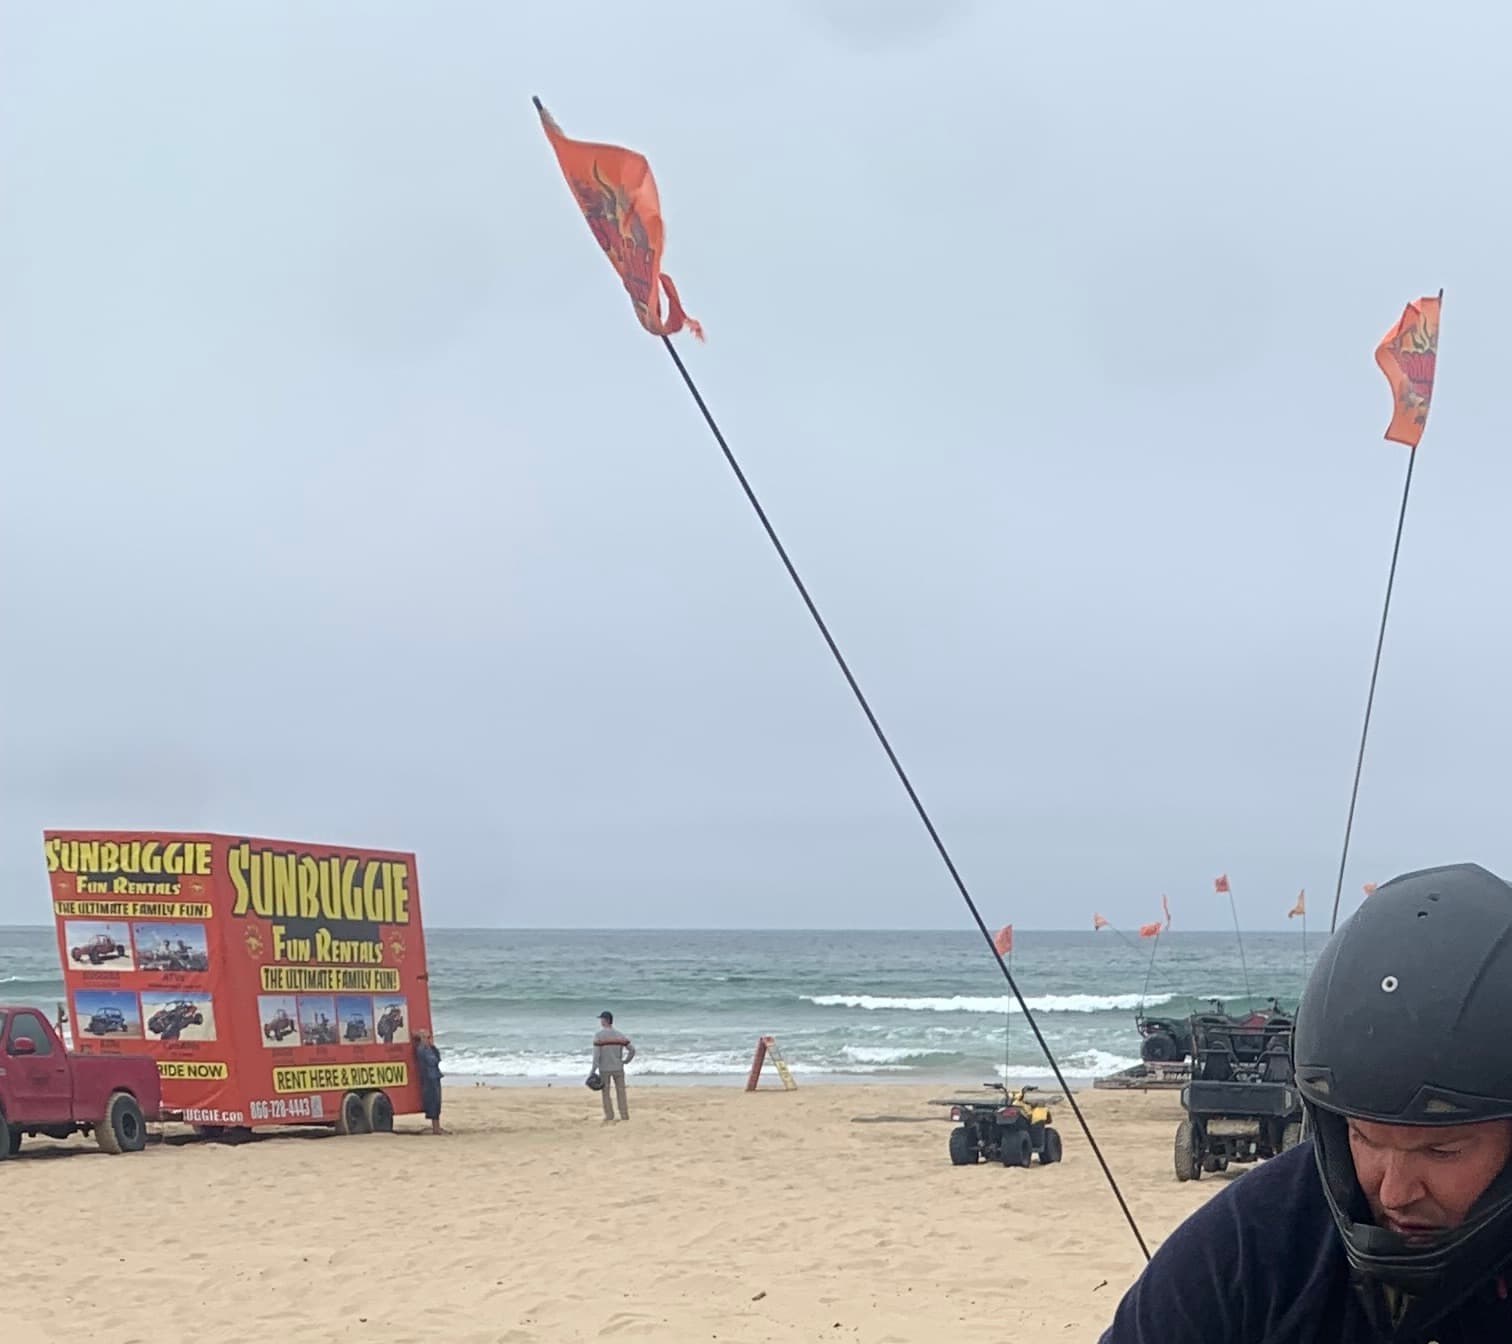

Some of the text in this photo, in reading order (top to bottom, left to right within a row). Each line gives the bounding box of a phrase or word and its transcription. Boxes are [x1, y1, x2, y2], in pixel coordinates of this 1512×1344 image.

[46, 838, 212, 874] SUNBUGGIE
[228, 843, 409, 923] SUNBUGGIE
[57, 902, 208, 917] THE ULTIMATE FAMILY FUN!
[264, 967, 397, 990] THE ULTIMATE FAMILY FUN!
[158, 1064, 223, 1078] RIDE NOW
[276, 1065, 404, 1090] RENT HERE & RIDE NOW
